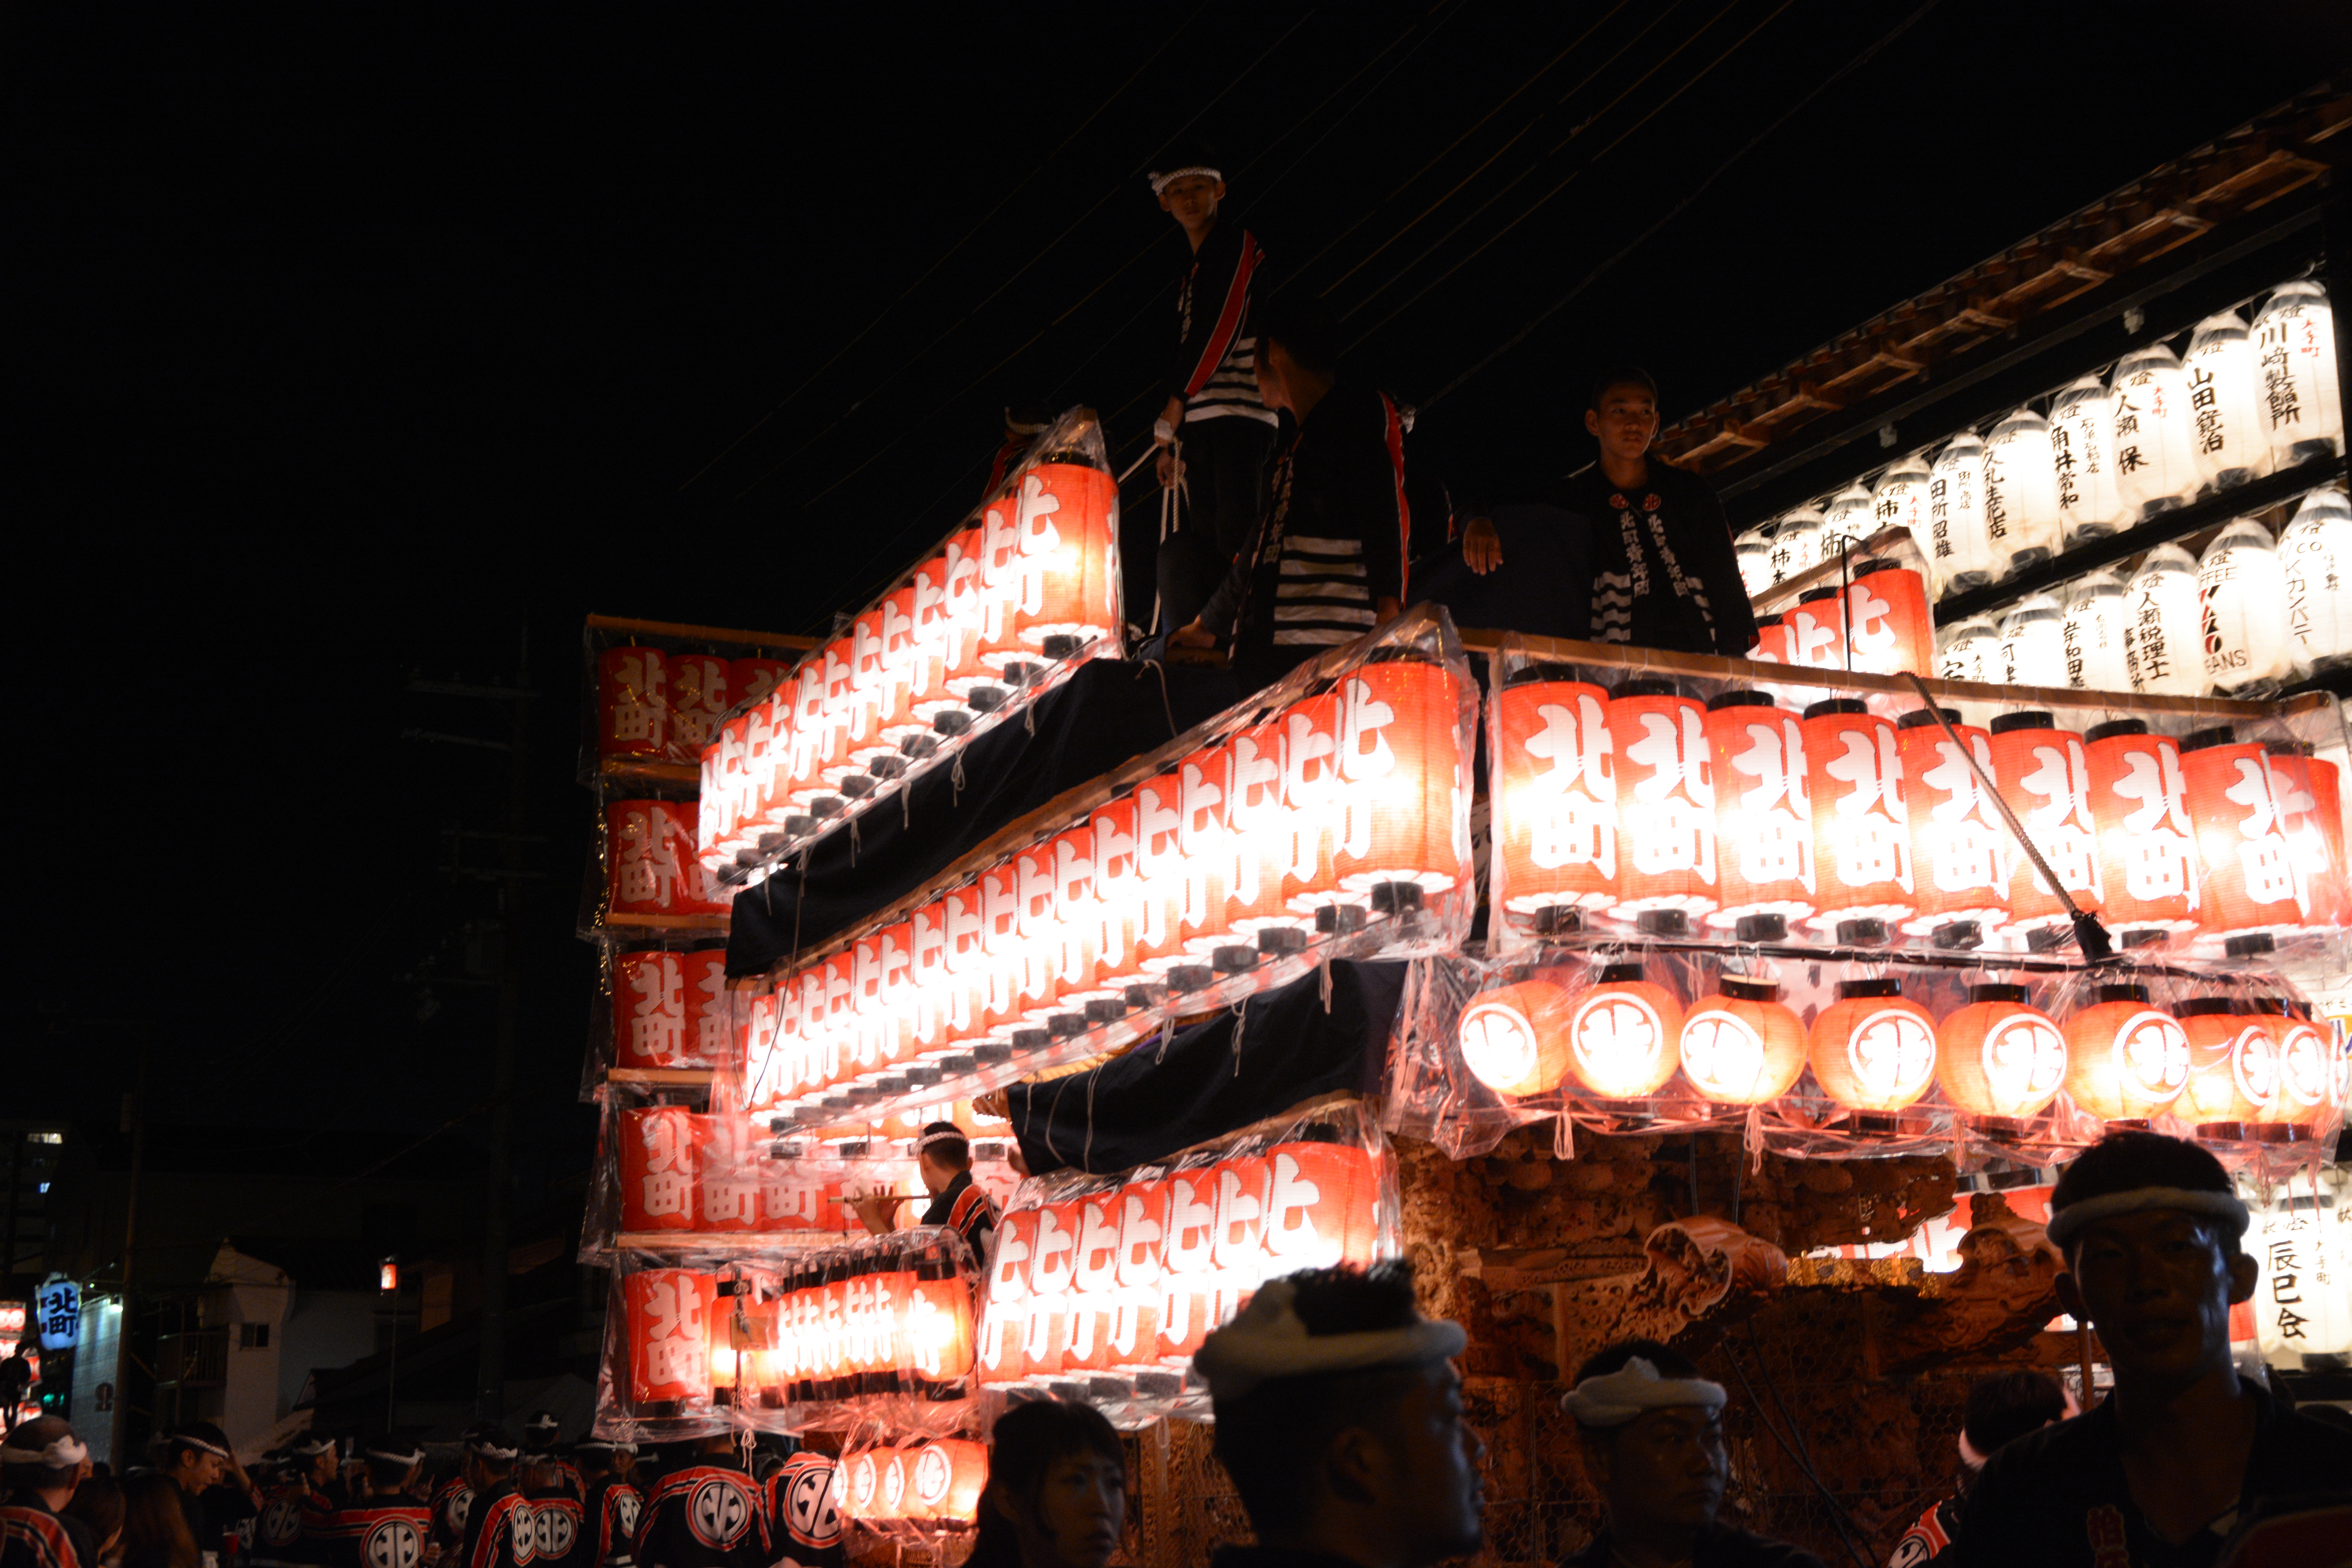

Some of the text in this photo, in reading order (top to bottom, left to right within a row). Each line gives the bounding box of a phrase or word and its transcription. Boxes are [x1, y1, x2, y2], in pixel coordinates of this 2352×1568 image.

[2301, 319, 2321, 358] 大手町
[2152, 386, 2167, 418] 大手町
[1874, 500, 1900, 528] 柿
[1907, 496, 1921, 528] 大手町
[615, 652, 666, 749] 北町
[1525, 694, 1617, 881] 北町
[1627, 705, 1717, 885] 北町
[1733, 718, 1817, 895] 北町
[1825, 723, 1915, 895] 北町
[1921, 734, 2009, 901] 北町
[2020, 739, 2105, 904] 北町
[2112, 742, 2201, 911] 北町
[2225, 749, 2310, 918] 北町
[619, 806, 676, 908] 北町
[630, 957, 685, 1058] 北町
[641, 1110, 693, 1222] 北町
[49, 1287, 78, 1338] 北町
[2267, 1240, 2310, 1339] 辰巳会
[2314, 1240, 2330, 1285] 大手町
[644, 1274, 704, 1390] 北町
